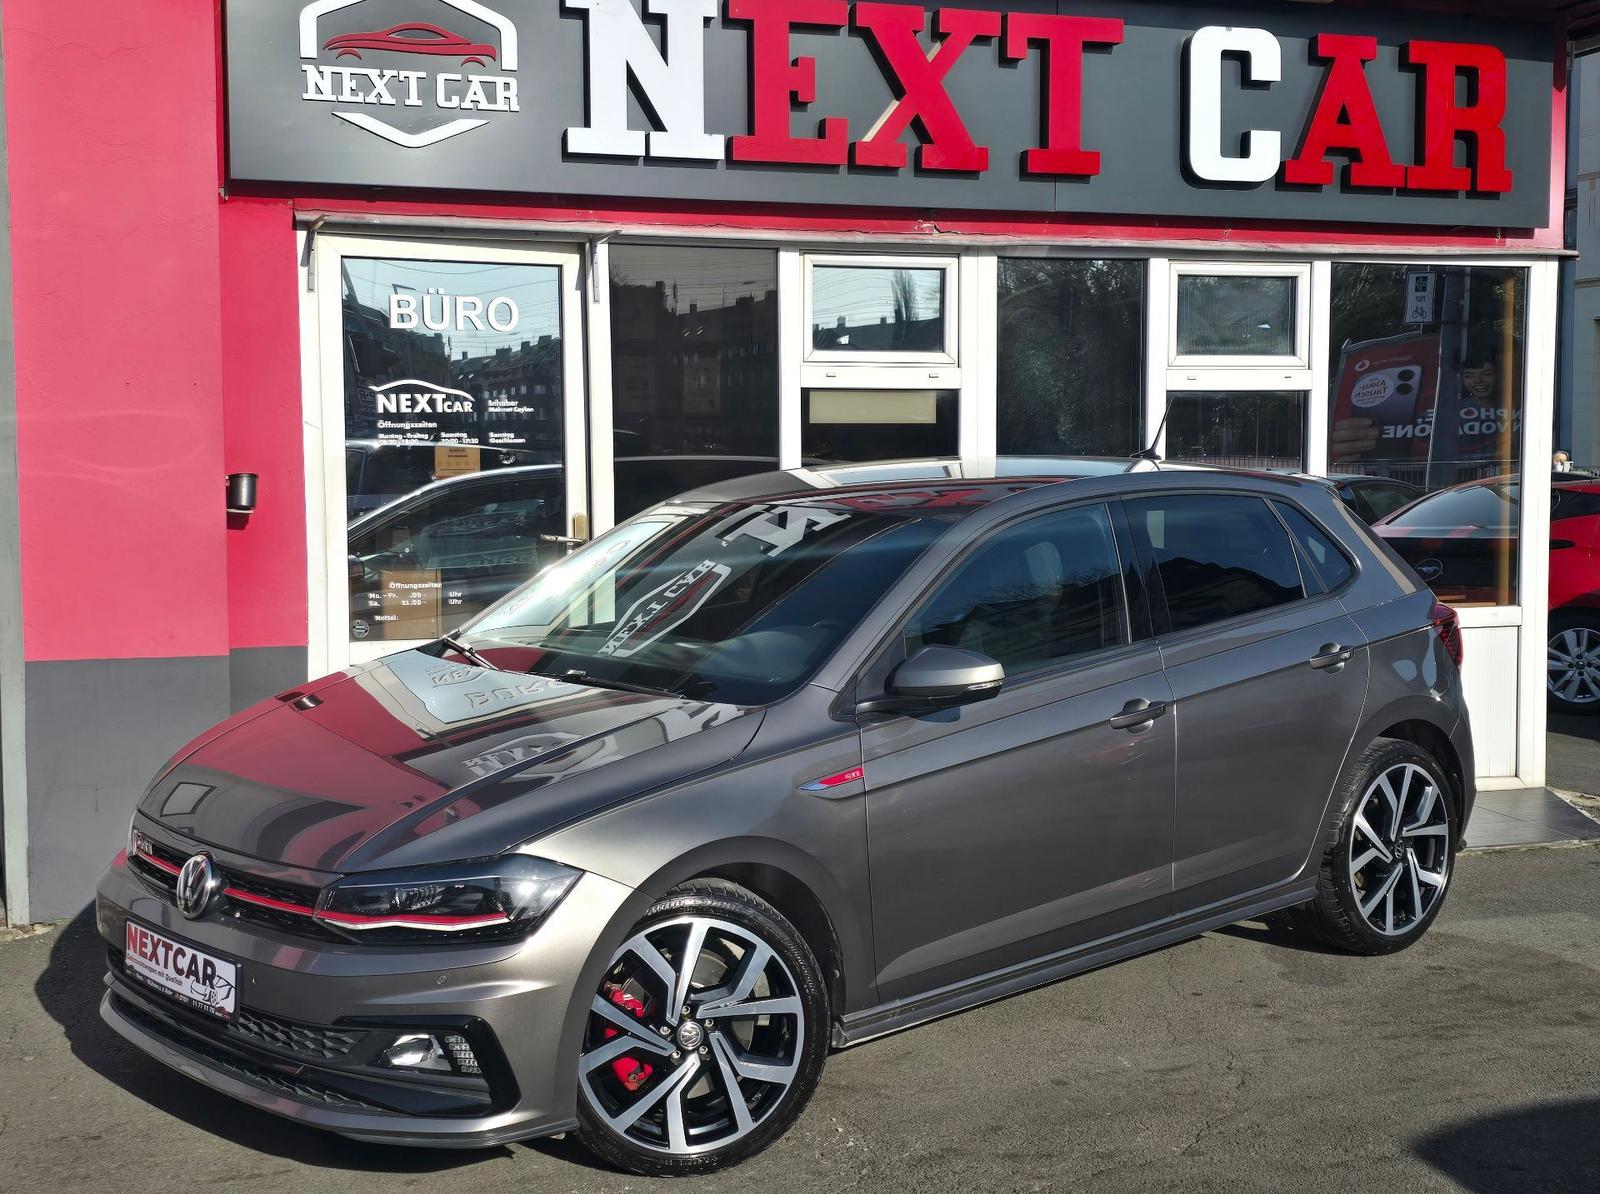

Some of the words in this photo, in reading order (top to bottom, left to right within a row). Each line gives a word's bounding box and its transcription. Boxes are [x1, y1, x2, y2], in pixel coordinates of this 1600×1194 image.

[302, 64, 427, 107] NEXT
[437, 74, 519, 112] CAR
[563, 0, 1124, 176] NEXT
[1190, 26, 1513, 192] CAR
[389, 288, 520, 331] BÜRO
[377, 419, 438, 429] Öffnungszeiten
[389, 581, 443, 590] Öffnungszeiten
[127, 923, 217, 990] NEXTCAR
